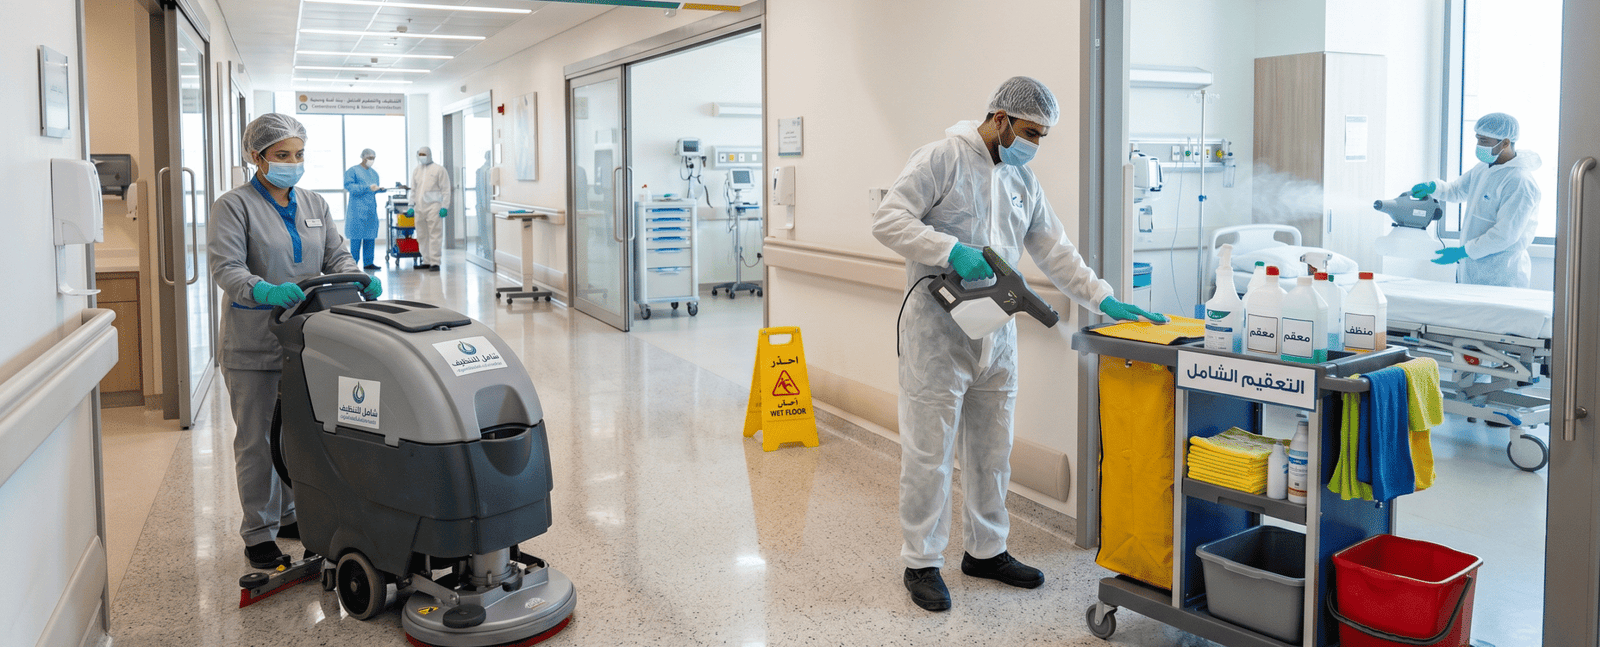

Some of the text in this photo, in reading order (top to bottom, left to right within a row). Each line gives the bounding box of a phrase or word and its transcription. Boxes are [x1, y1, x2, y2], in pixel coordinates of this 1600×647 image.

[1250, 328, 1275, 339] معقم
[1345, 325, 1373, 336] منظف
[1283, 332, 1311, 343] معقم
[1187, 363, 1305, 395] التعقيم الشامل
[770, 407, 807, 417] WET FLOOR
